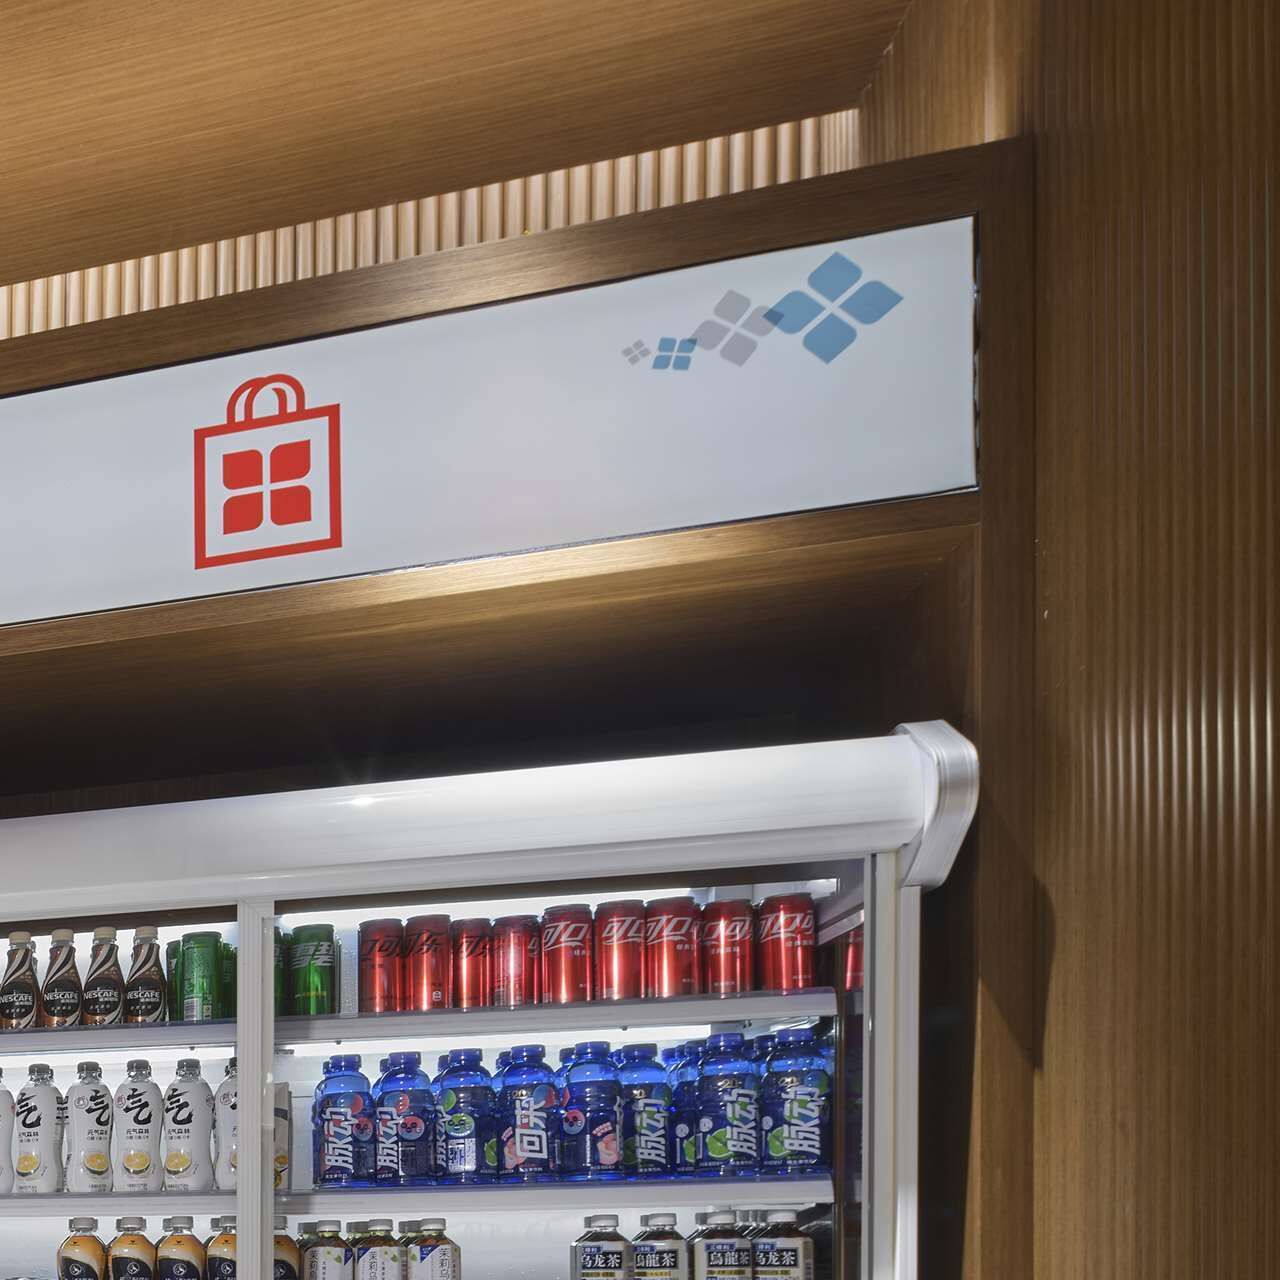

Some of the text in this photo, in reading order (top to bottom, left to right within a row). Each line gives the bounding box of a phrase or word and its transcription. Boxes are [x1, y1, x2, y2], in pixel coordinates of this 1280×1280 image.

[580, 1253, 622, 1268] 乌龙茶
[756, 1251, 796, 1266] 乌龙茶
